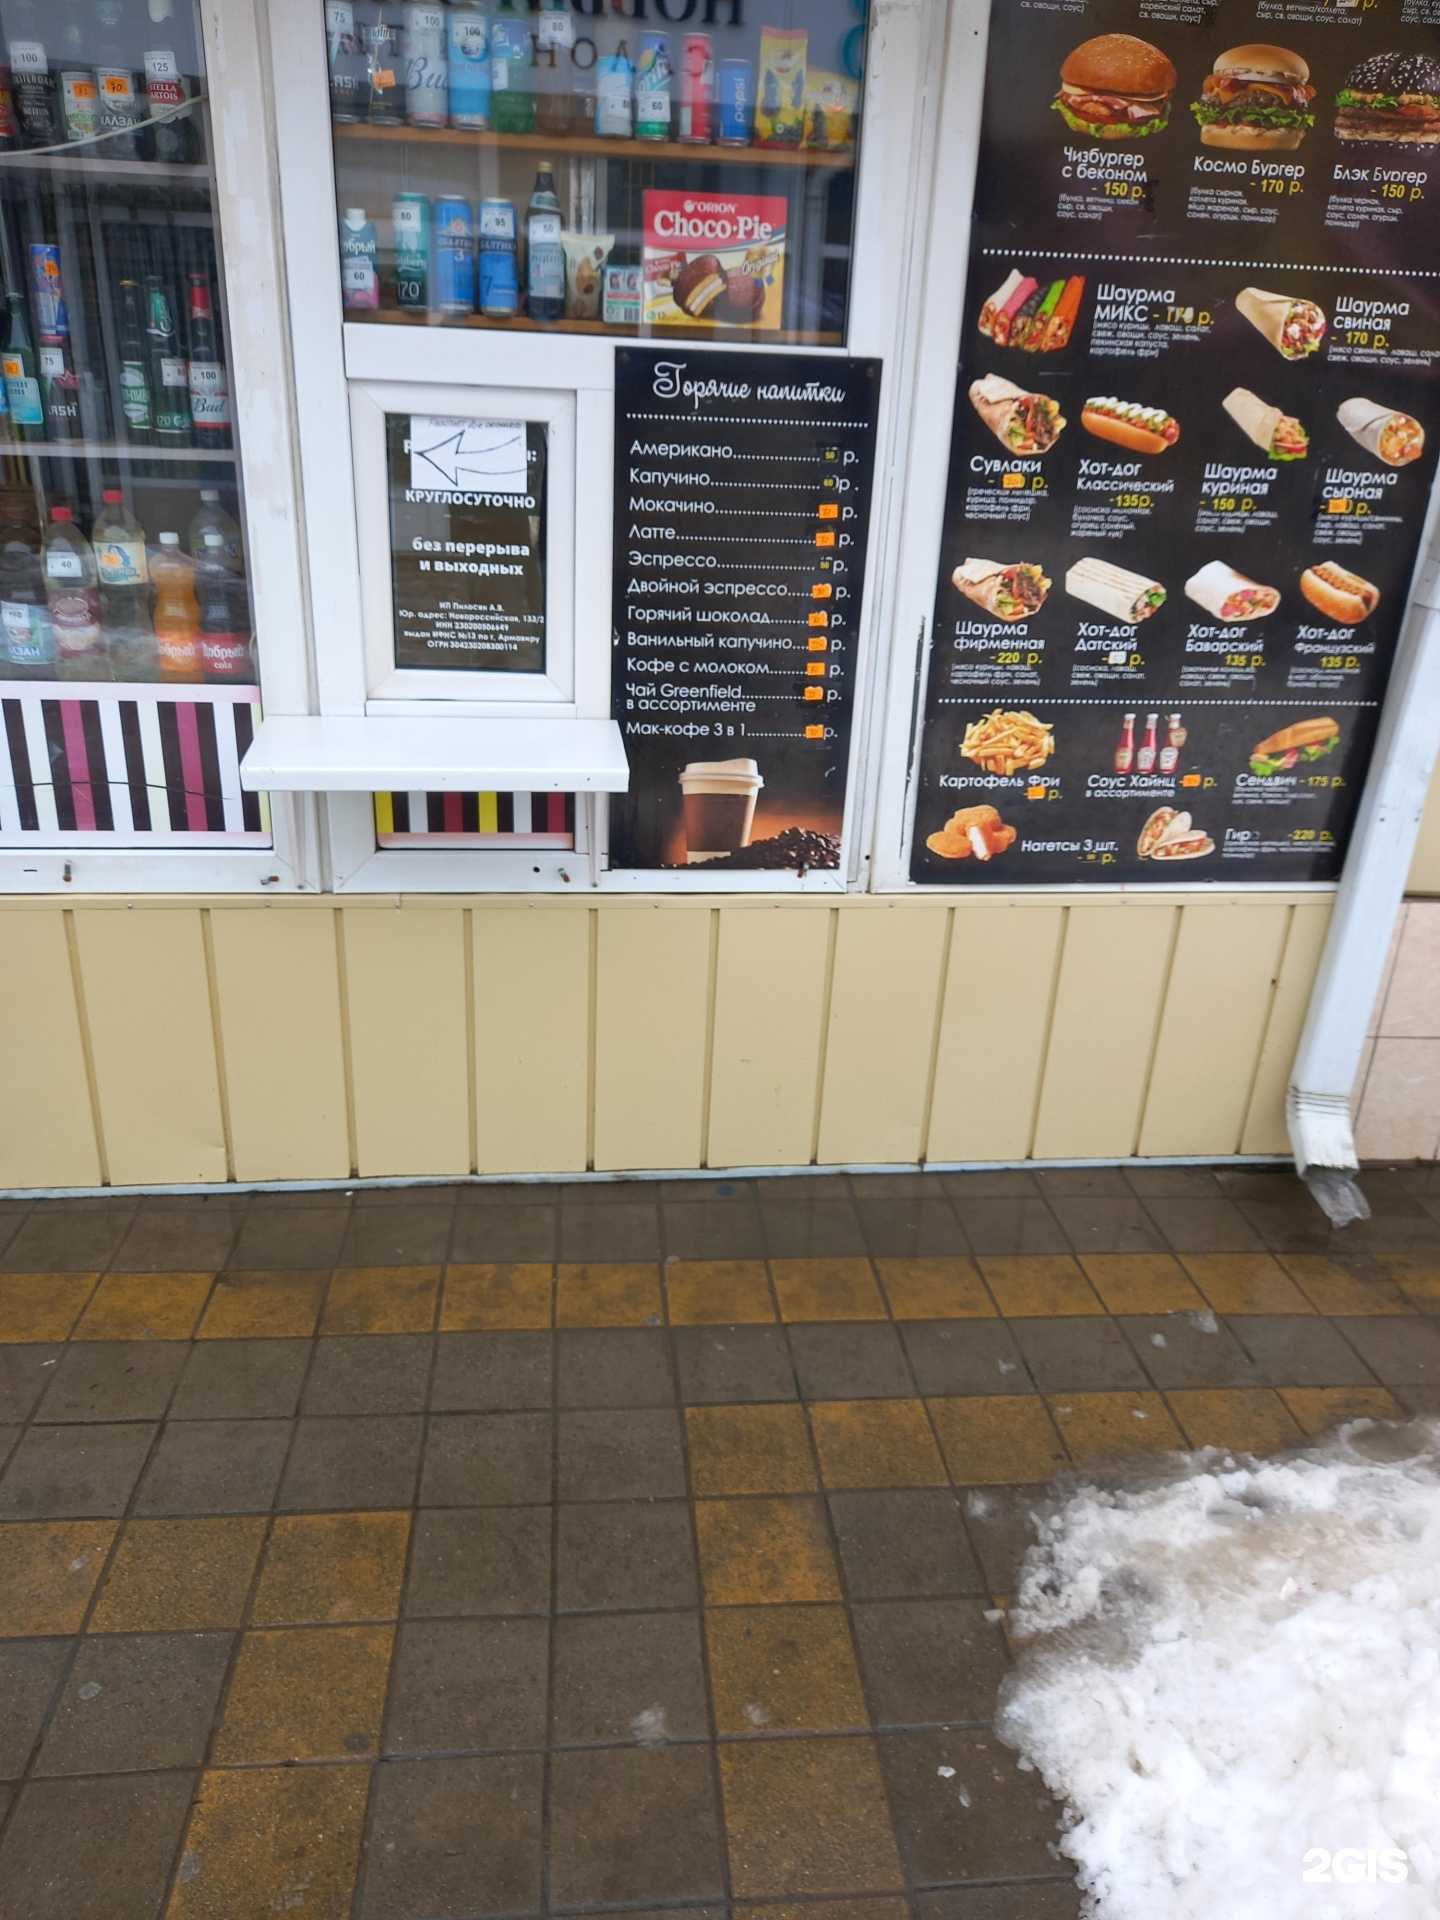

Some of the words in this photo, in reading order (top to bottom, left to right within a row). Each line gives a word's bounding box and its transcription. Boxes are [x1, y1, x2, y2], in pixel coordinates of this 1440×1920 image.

[21, 54, 38, 63] 100
[152, 63, 169, 72] 125
[1063, 146, 1144, 169] Чизбургер
[1193, 156, 1247, 175] Космо
[1062, 166, 1072, 178] с
[1077, 163, 1148, 182] беконом
[1333, 164, 1370, 181] Блэк
[1103, 182, 1128, 196] 150
[1131, 185, 1147, 200] р.
[1260, 179, 1283, 193] 170
[1288, 181, 1304, 195] р.
[1382, 184, 1405, 198] 150
[1409, 187, 1425, 202] р.
[1097, 284, 1175, 305] Шаурма
[1336, 296, 1410, 316] Шаурма
[1094, 305, 1148, 322] МИКС
[1197, 312, 1214, 328] р.
[1333, 317, 1391, 331] свиная
[1346, 332, 1368, 344] 170
[1372, 334, 1389, 350] р.
[652, 362, 751, 409] Горячие
[757, 381, 846, 403] напитки
[629, 441, 733, 460] Американо
[843, 450, 860, 466] р.
[970, 456, 1042, 475] Сувлаки
[1078, 459, 1142, 476] Хот-дог
[1204, 463, 1278, 482] Шаурма
[629, 468, 711, 487] Капучино
[1031, 476, 1049, 492] р.
[1076, 479, 1175, 492] Классический
[1325, 468, 1398, 487] Шаурма
[1201, 481, 1269, 497] куриная
[1322, 485, 1383, 500] сырная
[405, 489, 535, 509] КРУГЛОСУТОЧНО
[1241, 498, 1257, 511] р.
[629, 498, 715, 513] Мокачино
[842, 506, 858, 521] р.
[1355, 502, 1372, 516] р.
[629, 525, 676, 540] Латте
[839, 533, 855, 548] р.
[412, 537, 442, 552] без
[445, 540, 530, 557] перерыва
[419, 561, 431, 572] и
[434, 561, 524, 576] выходных
[628, 551, 717, 570] Эспрессо
[833, 559, 849, 575] р.
[627, 578, 699, 594] Двойной
[704, 580, 788, 597] эспрессо
[835, 585, 851, 600] р.
[399, 610, 415, 619] Юр.
[627, 605, 692, 623] Горячий
[696, 610, 770, 624] шоколад
[831, 612, 846, 627] р.
[955, 621, 1028, 637] Шаурма
[1077, 622, 1138, 637] Хот-дог
[1187, 624, 1247, 638] Хот-дог
[1296, 625, 1356, 640] Хот-дог
[428, 640, 448, 649] ОГРН
[627, 632, 714, 648] Ванильный
[718, 637, 793, 651] капучино
[830, 638, 846, 652] р.
[954, 636, 1045, 651] фирменная
[1075, 637, 1137, 652] Датский
[1185, 639, 1264, 654] Баварский
[626, 657, 675, 674] Кофе
[679, 662, 689, 672] с
[694, 662, 769, 674] молоком
[829, 662, 845, 677] р.
[1026, 653, 1042, 667] р.
[1129, 654, 1145, 668] р.
[1225, 655, 1247, 666] 135
[1250, 655, 1266, 667] р.
[1320, 656, 1341, 668] 135
[1345, 657, 1360, 668] р.
[625, 682, 656, 698] Чай
[660, 684, 742, 699] Greenfield
[827, 687, 842, 702] р.
[626, 701, 634, 710] в
[638, 700, 756, 712] ассортименте
[626, 723, 710, 739] Мак-кофе
[714, 724, 724, 735] 3
[727, 726, 735, 735] в
[740, 724, 745, 735] 1
[939, 776, 1024, 789] Картофель
[1088, 774, 1126, 789] Соус
[1130, 775, 1175, 789] Хайнц
[1203, 776, 1217, 788] р.
[1235, 774, 1296, 787] Сендвич
[1048, 789, 1063, 801] р.
[1094, 788, 1175, 799] ассортименте
[1021, 840, 1079, 852] Нагетсы
[1083, 840, 1092, 851] 3
[1096, 840, 1119, 851] шт.
[1102, 853, 1116, 864] р.
